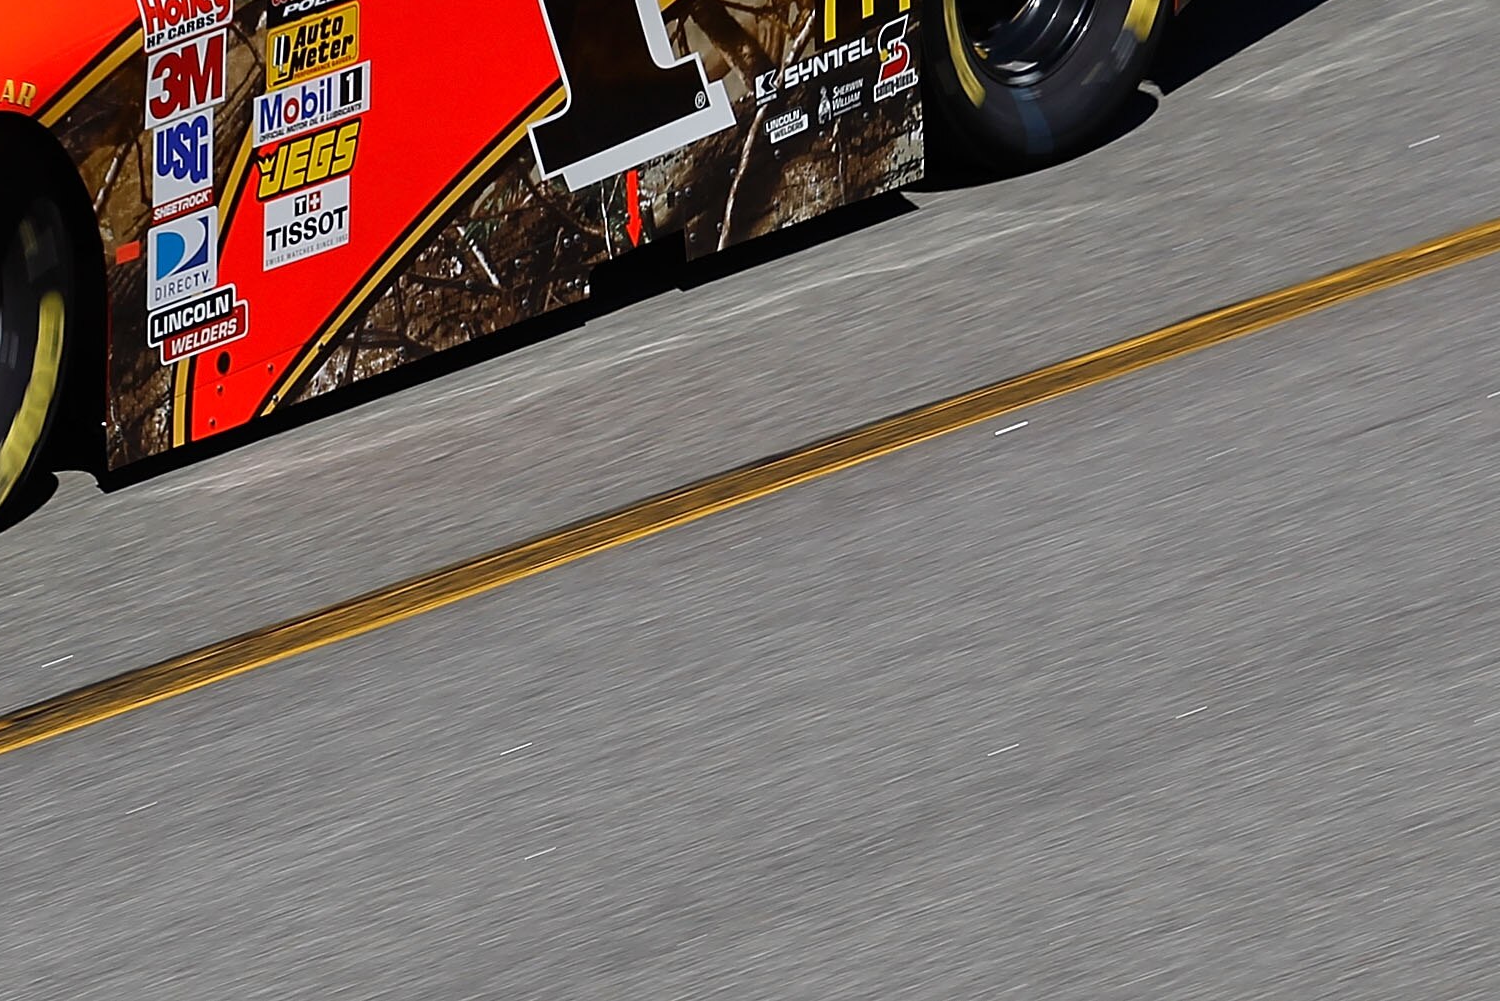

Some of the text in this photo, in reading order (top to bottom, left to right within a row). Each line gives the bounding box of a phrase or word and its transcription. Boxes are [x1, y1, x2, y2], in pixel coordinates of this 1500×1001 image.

[146, 14, 216, 49] HP CARBS
[294, 16, 343, 50] Auto
[290, 34, 354, 73] Meter
[785, 37, 873, 89] SYNTEL
[150, 35, 226, 120] 3M
[260, 72, 354, 133] Mobil 1
[765, 109, 800, 132] LINCOLN
[156, 115, 209, 184] USG
[258, 121, 360, 199] JEGS
[153, 189, 211, 222] SHEETROCK
[266, 205, 348, 252] TISSOT
[155, 269, 208, 301] DIRECTV
[154, 294, 229, 338] LINCOLN
[171, 318, 237, 356] WELDERS
